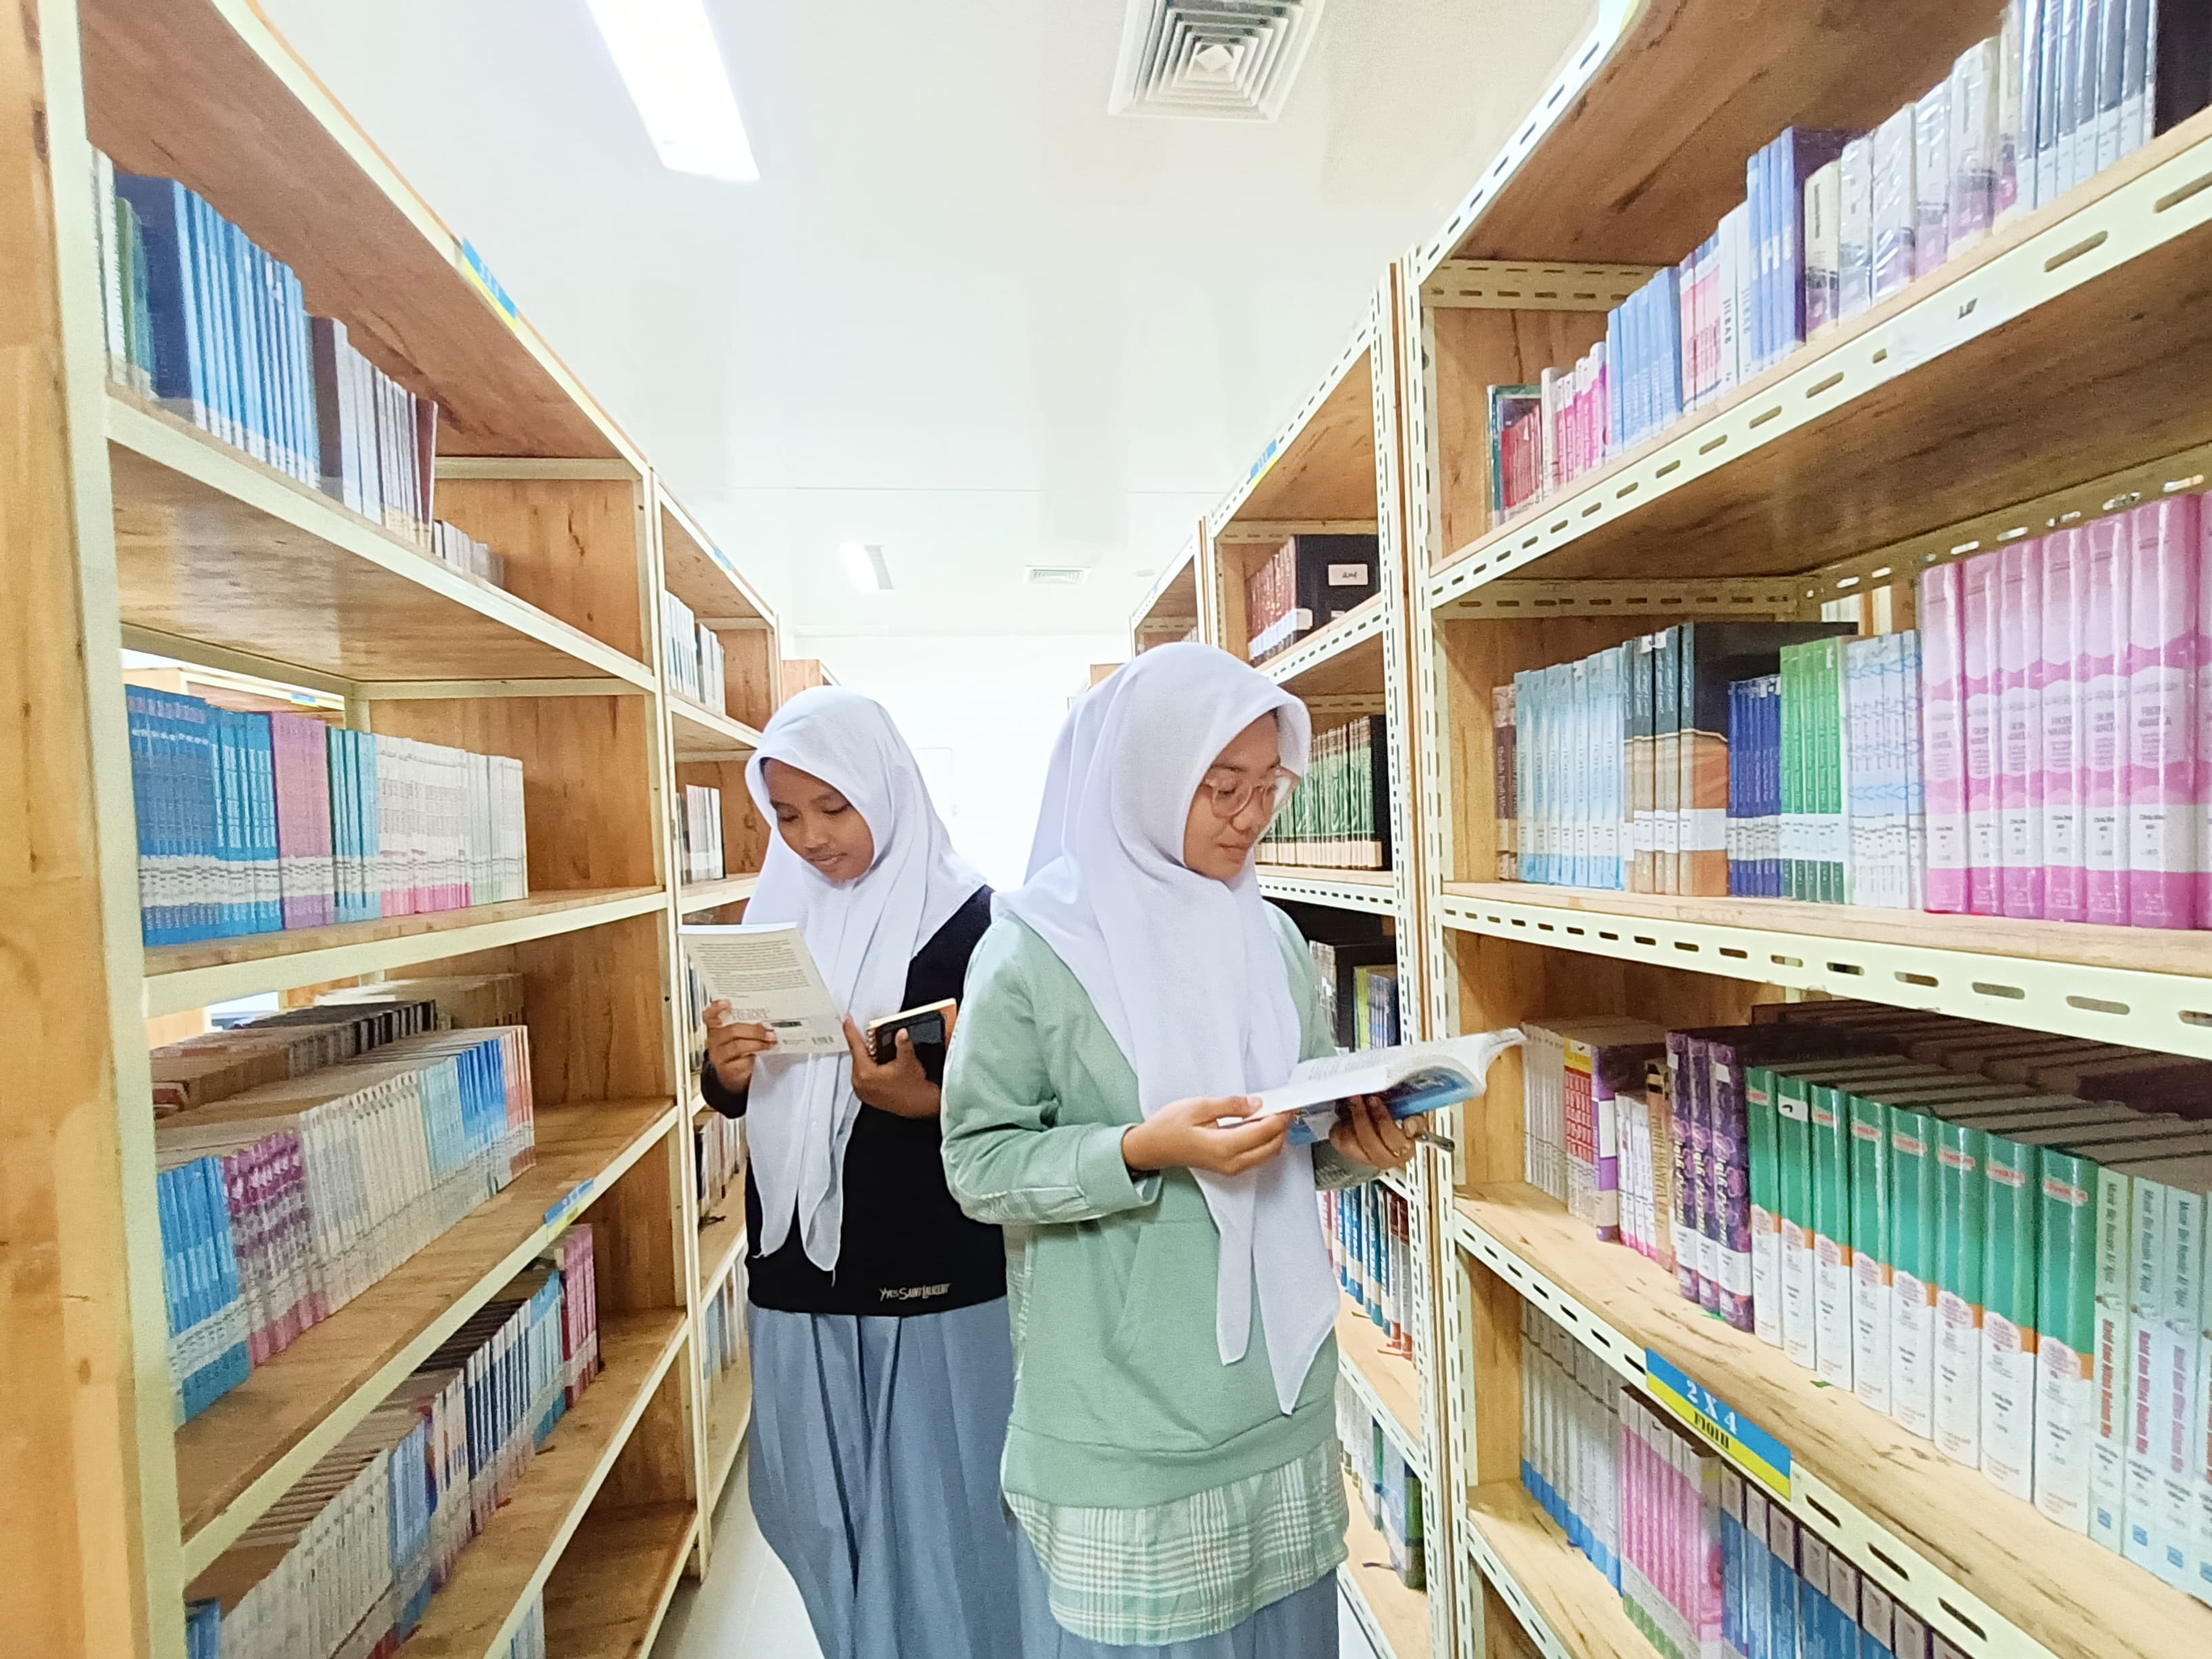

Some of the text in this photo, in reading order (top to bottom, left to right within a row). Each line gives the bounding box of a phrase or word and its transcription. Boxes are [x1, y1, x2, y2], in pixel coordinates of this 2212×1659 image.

[1685, 1378, 1738, 1435] 2 X 4
